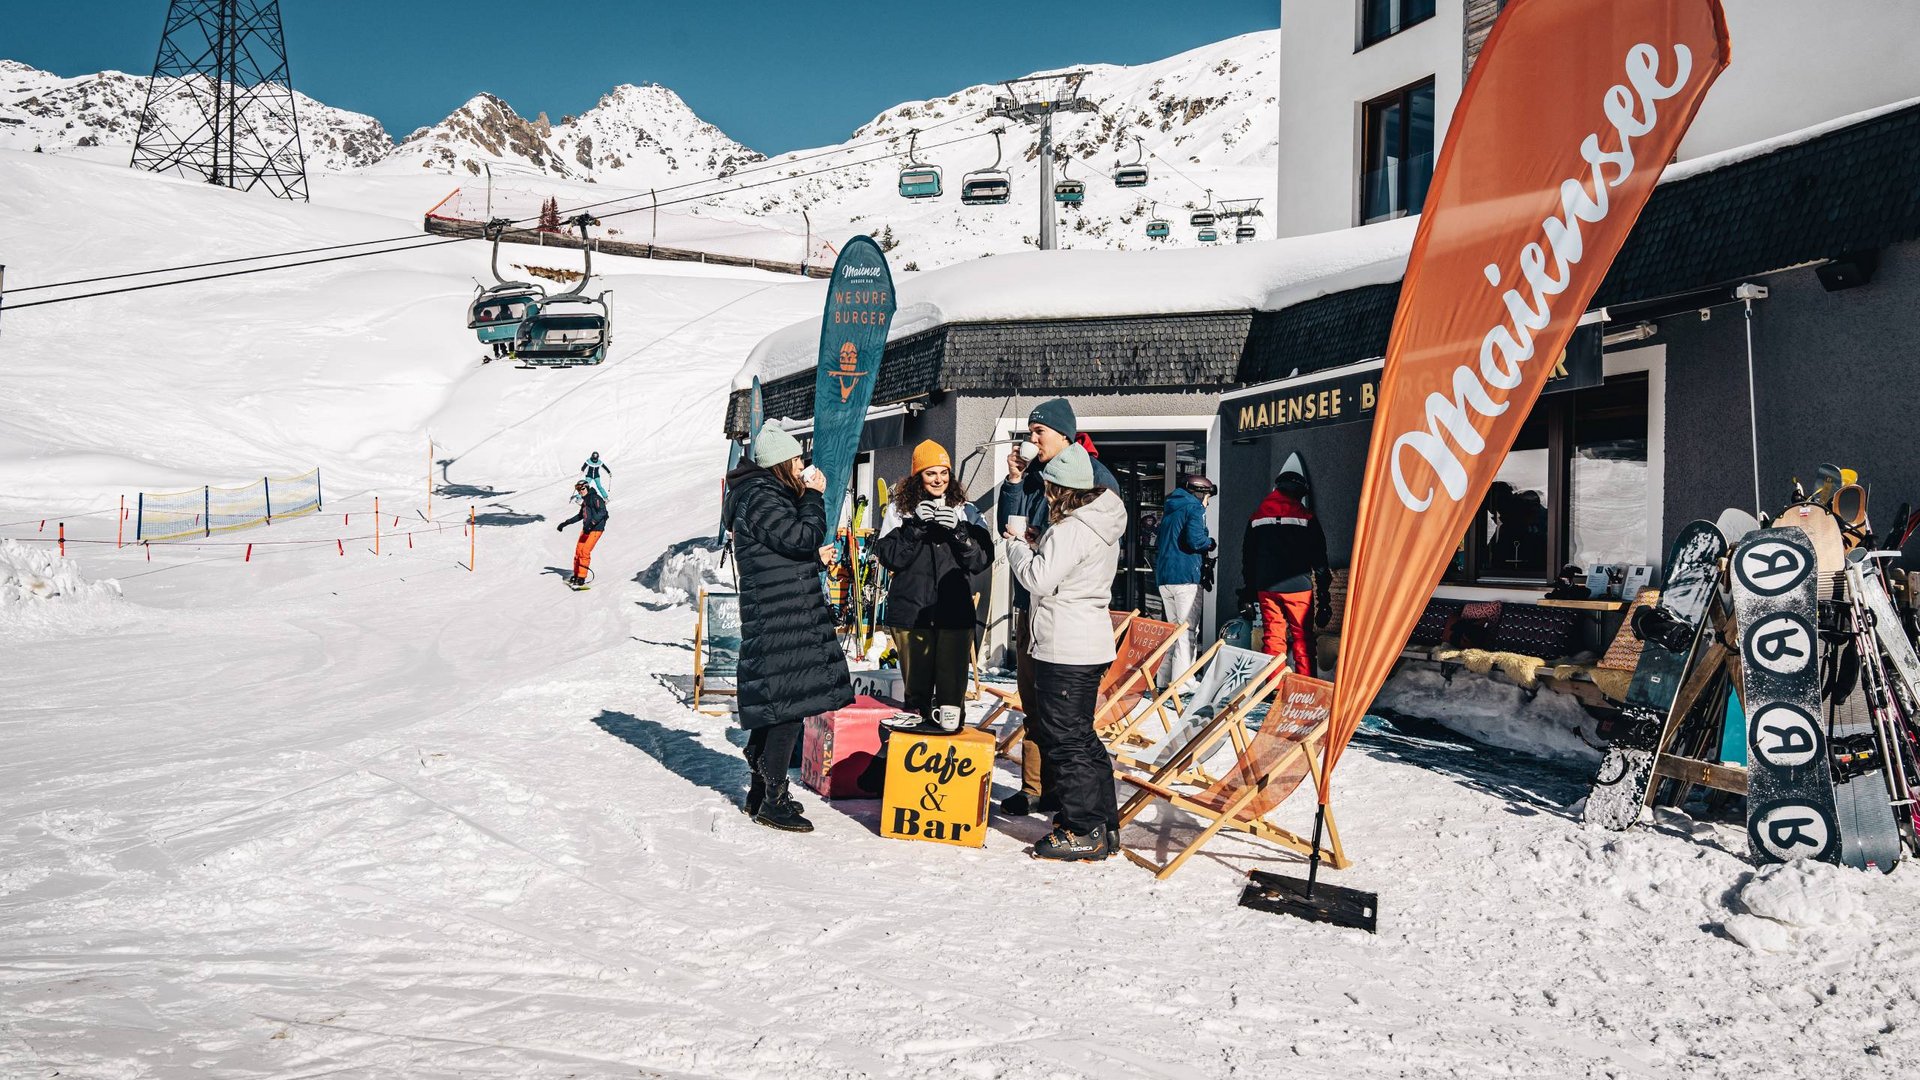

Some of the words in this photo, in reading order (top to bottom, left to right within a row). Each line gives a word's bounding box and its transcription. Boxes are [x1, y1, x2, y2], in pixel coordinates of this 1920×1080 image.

[842, 263, 881, 279] Maiensee
[1391, 43, 1692, 512] Maiensee
[835, 291, 852, 304] WE
[855, 291, 887, 305] SURF
[835, 311, 886, 325] BURGER
[1238, 388, 1342, 432] MAIENSEE
[1137, 622, 1165, 636] GOOD
[1133, 636, 1160, 649] VIBES
[904, 742, 976, 785] Cafe
[920, 782, 947, 812] &
[890, 806, 971, 841] Bar
